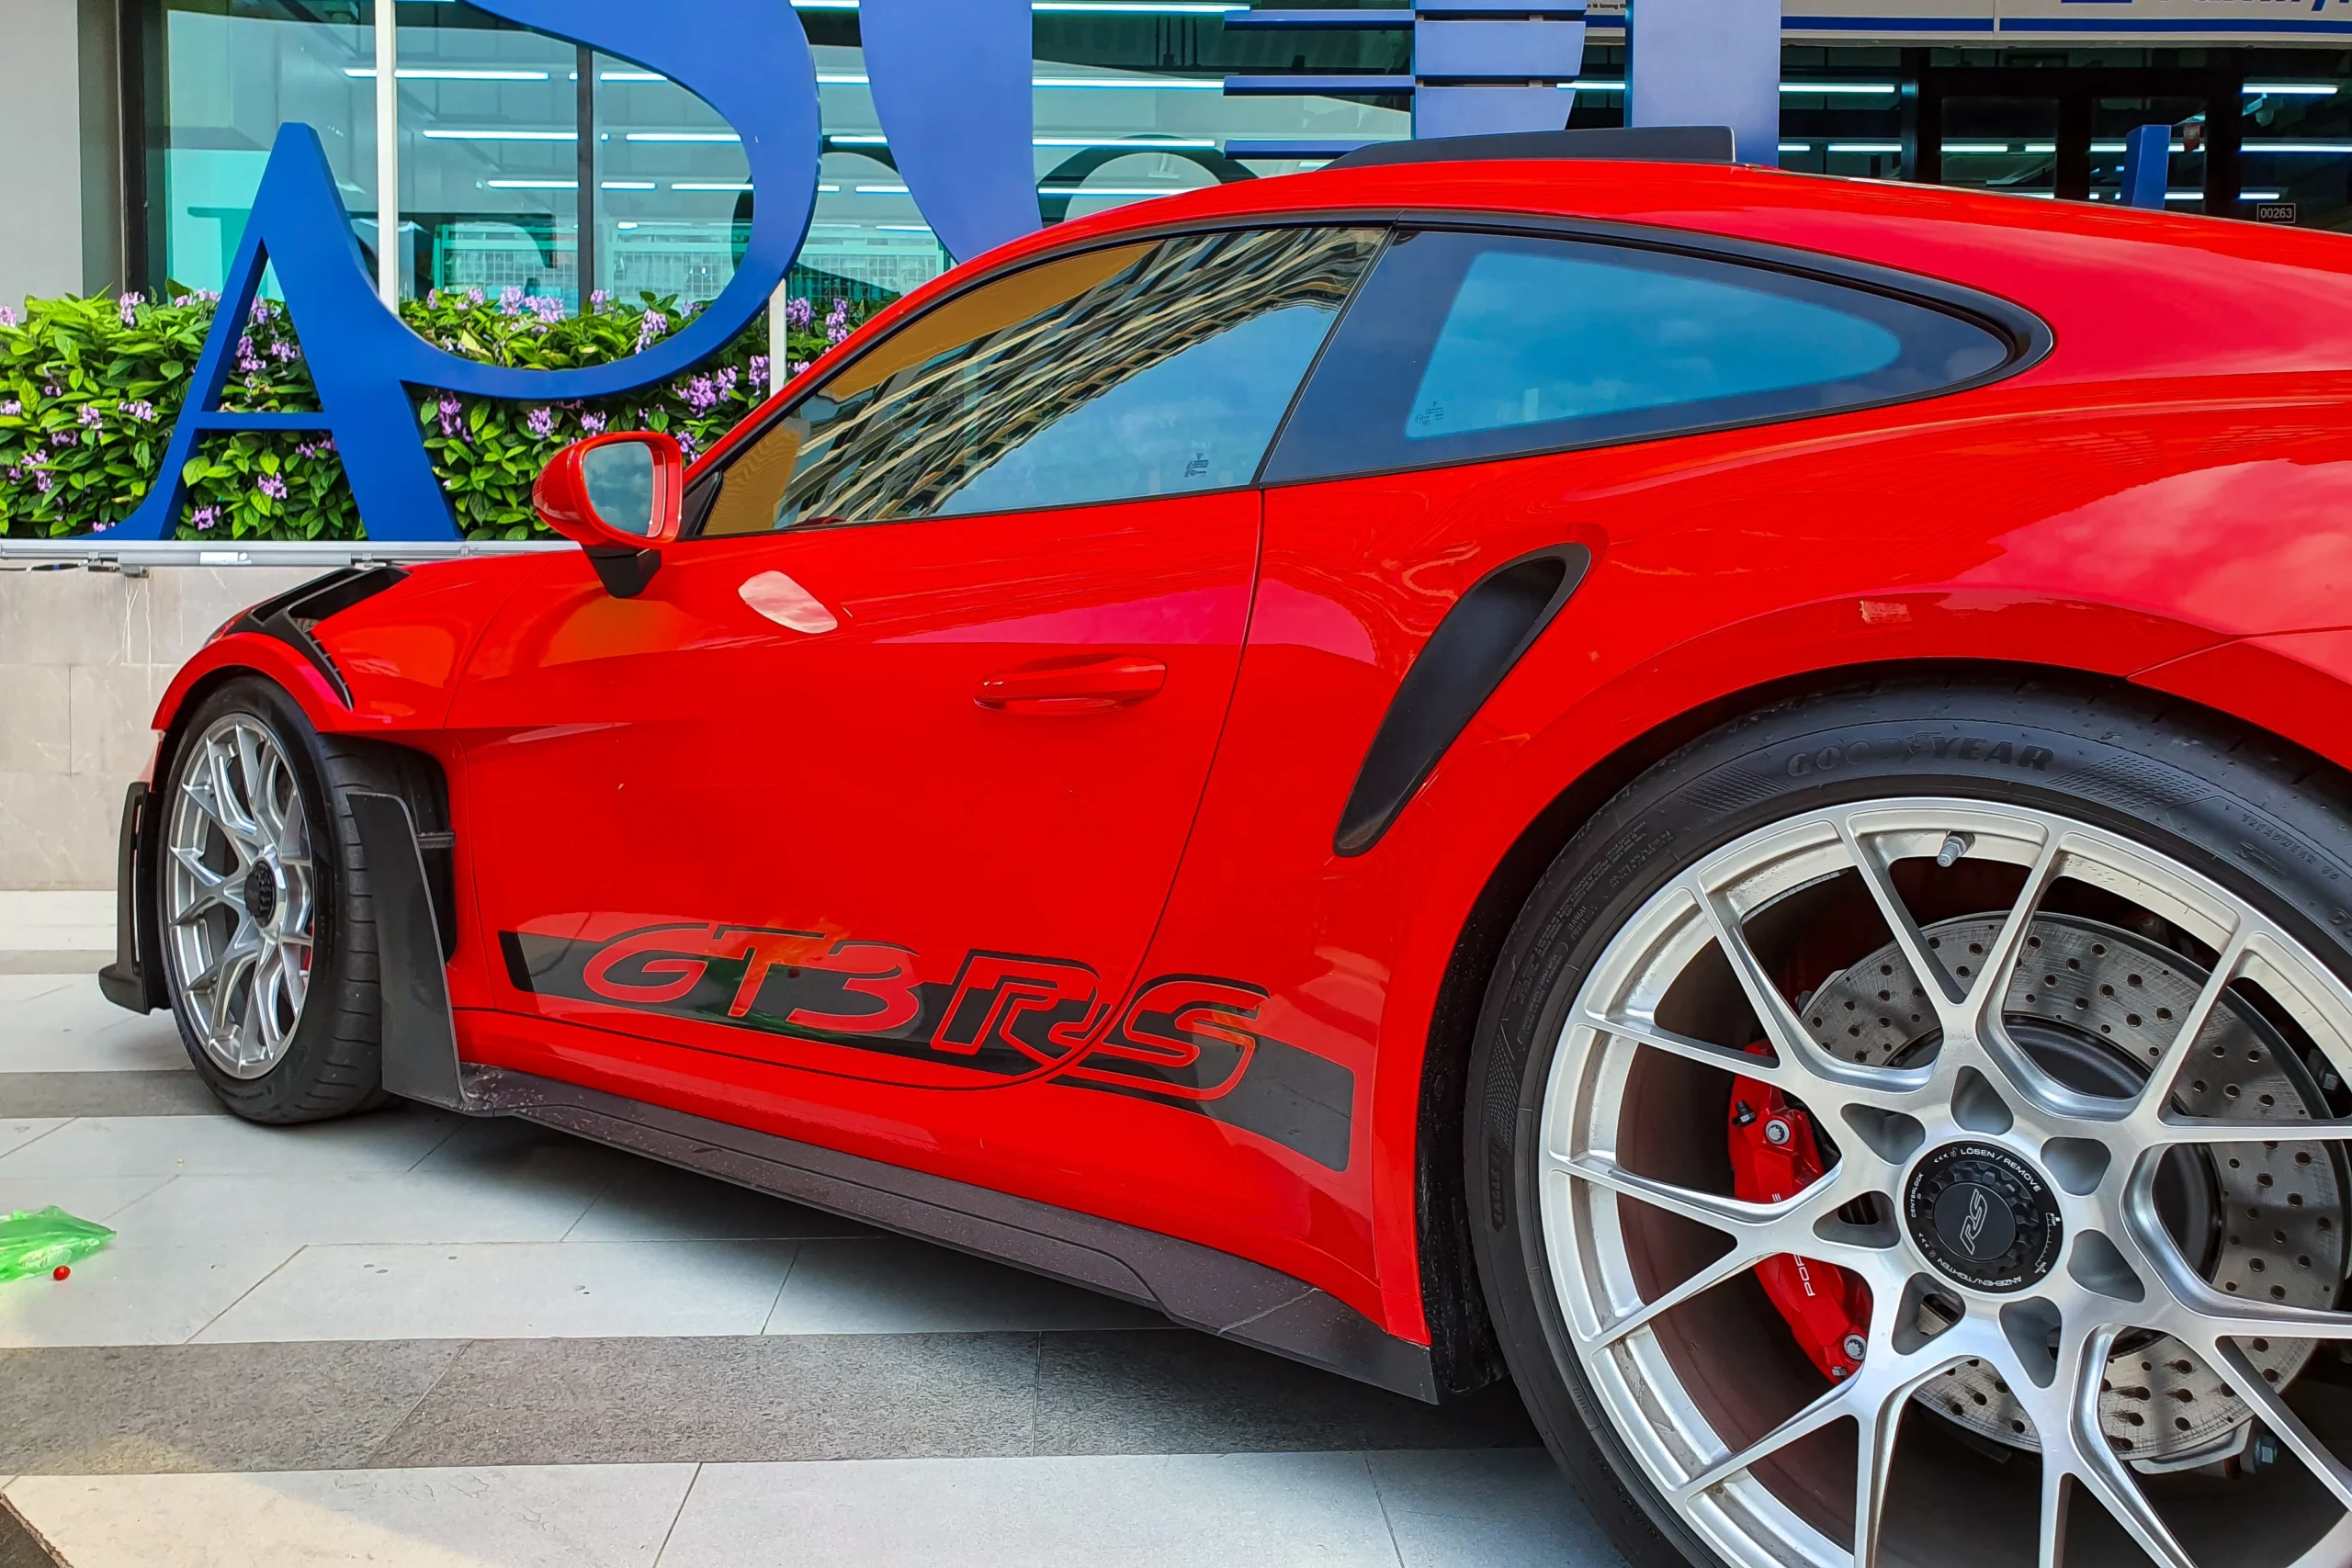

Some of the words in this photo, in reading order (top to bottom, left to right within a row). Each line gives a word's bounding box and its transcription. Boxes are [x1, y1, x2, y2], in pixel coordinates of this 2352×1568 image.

[2260, 208, 2292, 219] 00263
[1960, 1146, 1996, 1159] LÖSEN
[2003, 1157, 2042, 1192] REMOVE
[1911, 1171, 1925, 1219] CENTERLOCK
[1959, 1188, 1988, 1257] RS
